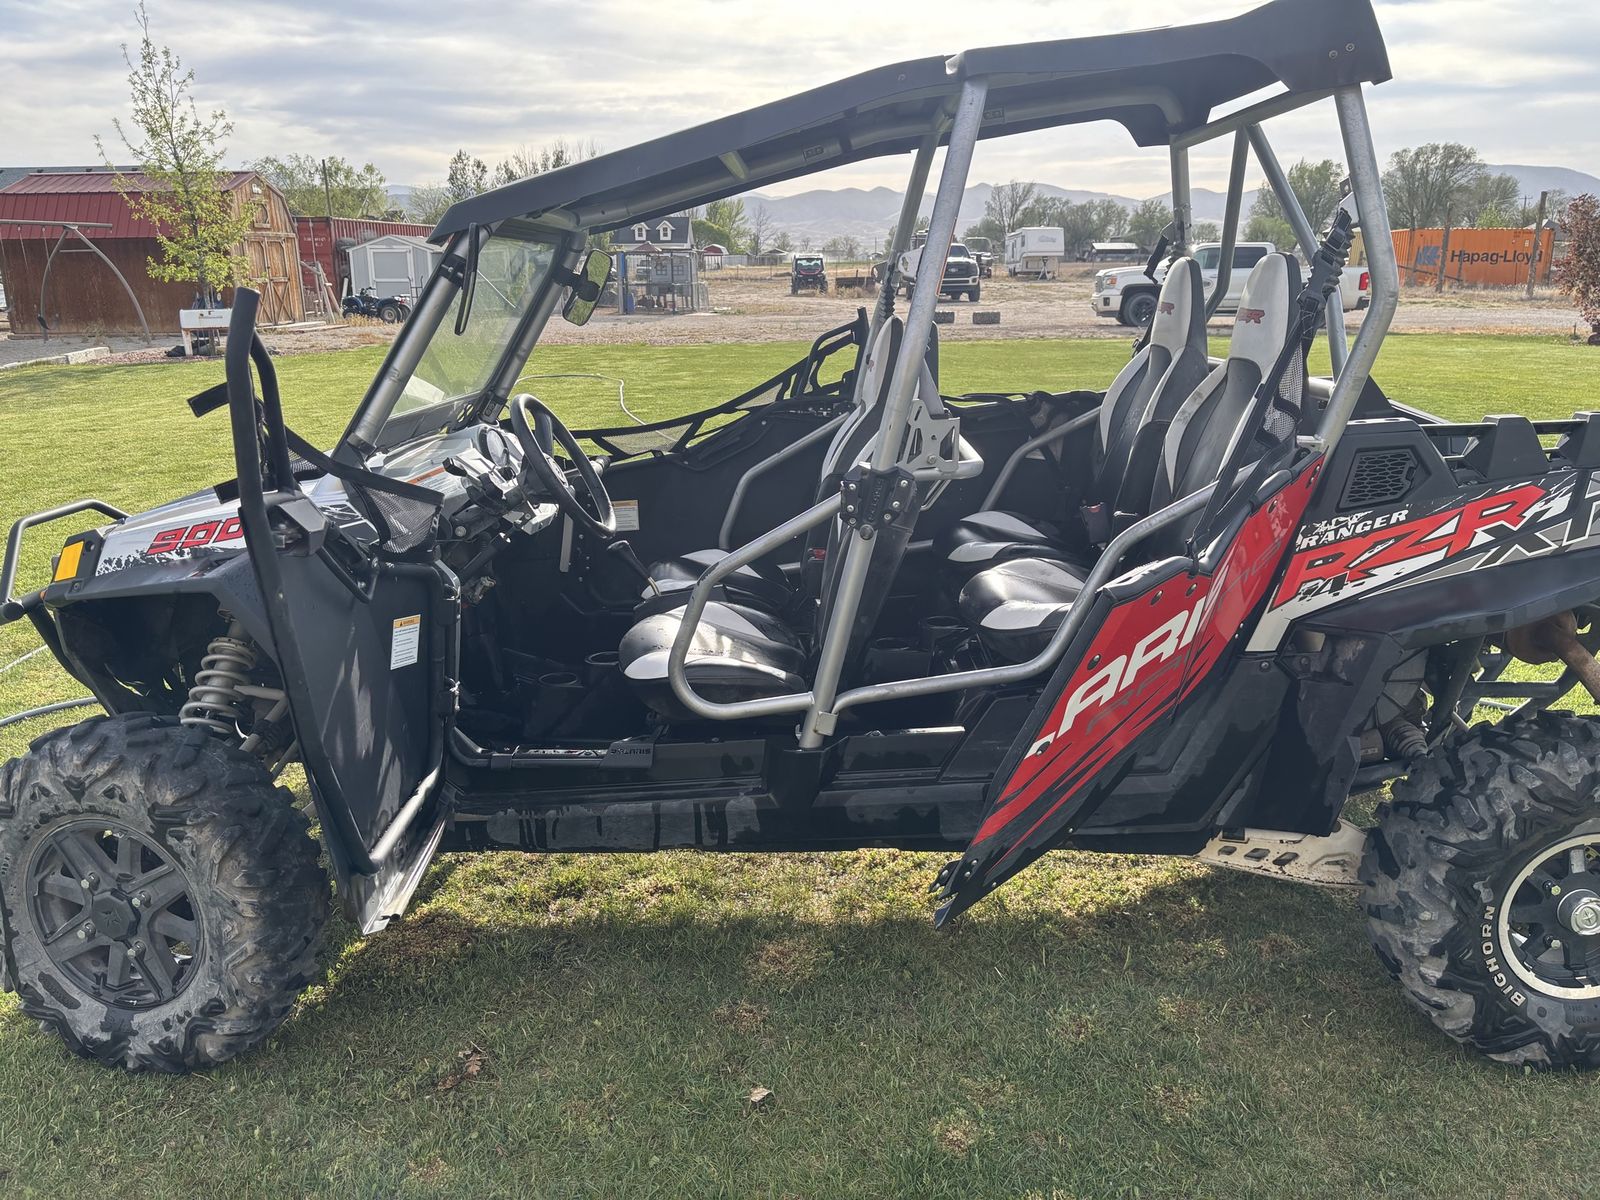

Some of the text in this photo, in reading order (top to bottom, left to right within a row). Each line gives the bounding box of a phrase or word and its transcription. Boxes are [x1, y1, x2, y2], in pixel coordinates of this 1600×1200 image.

[147, 516, 244, 556] 900
[1268, 484, 1546, 614] RZR
[1300, 509, 1408, 550] RANGER
[1482, 905, 1527, 1007] BIGHORN
